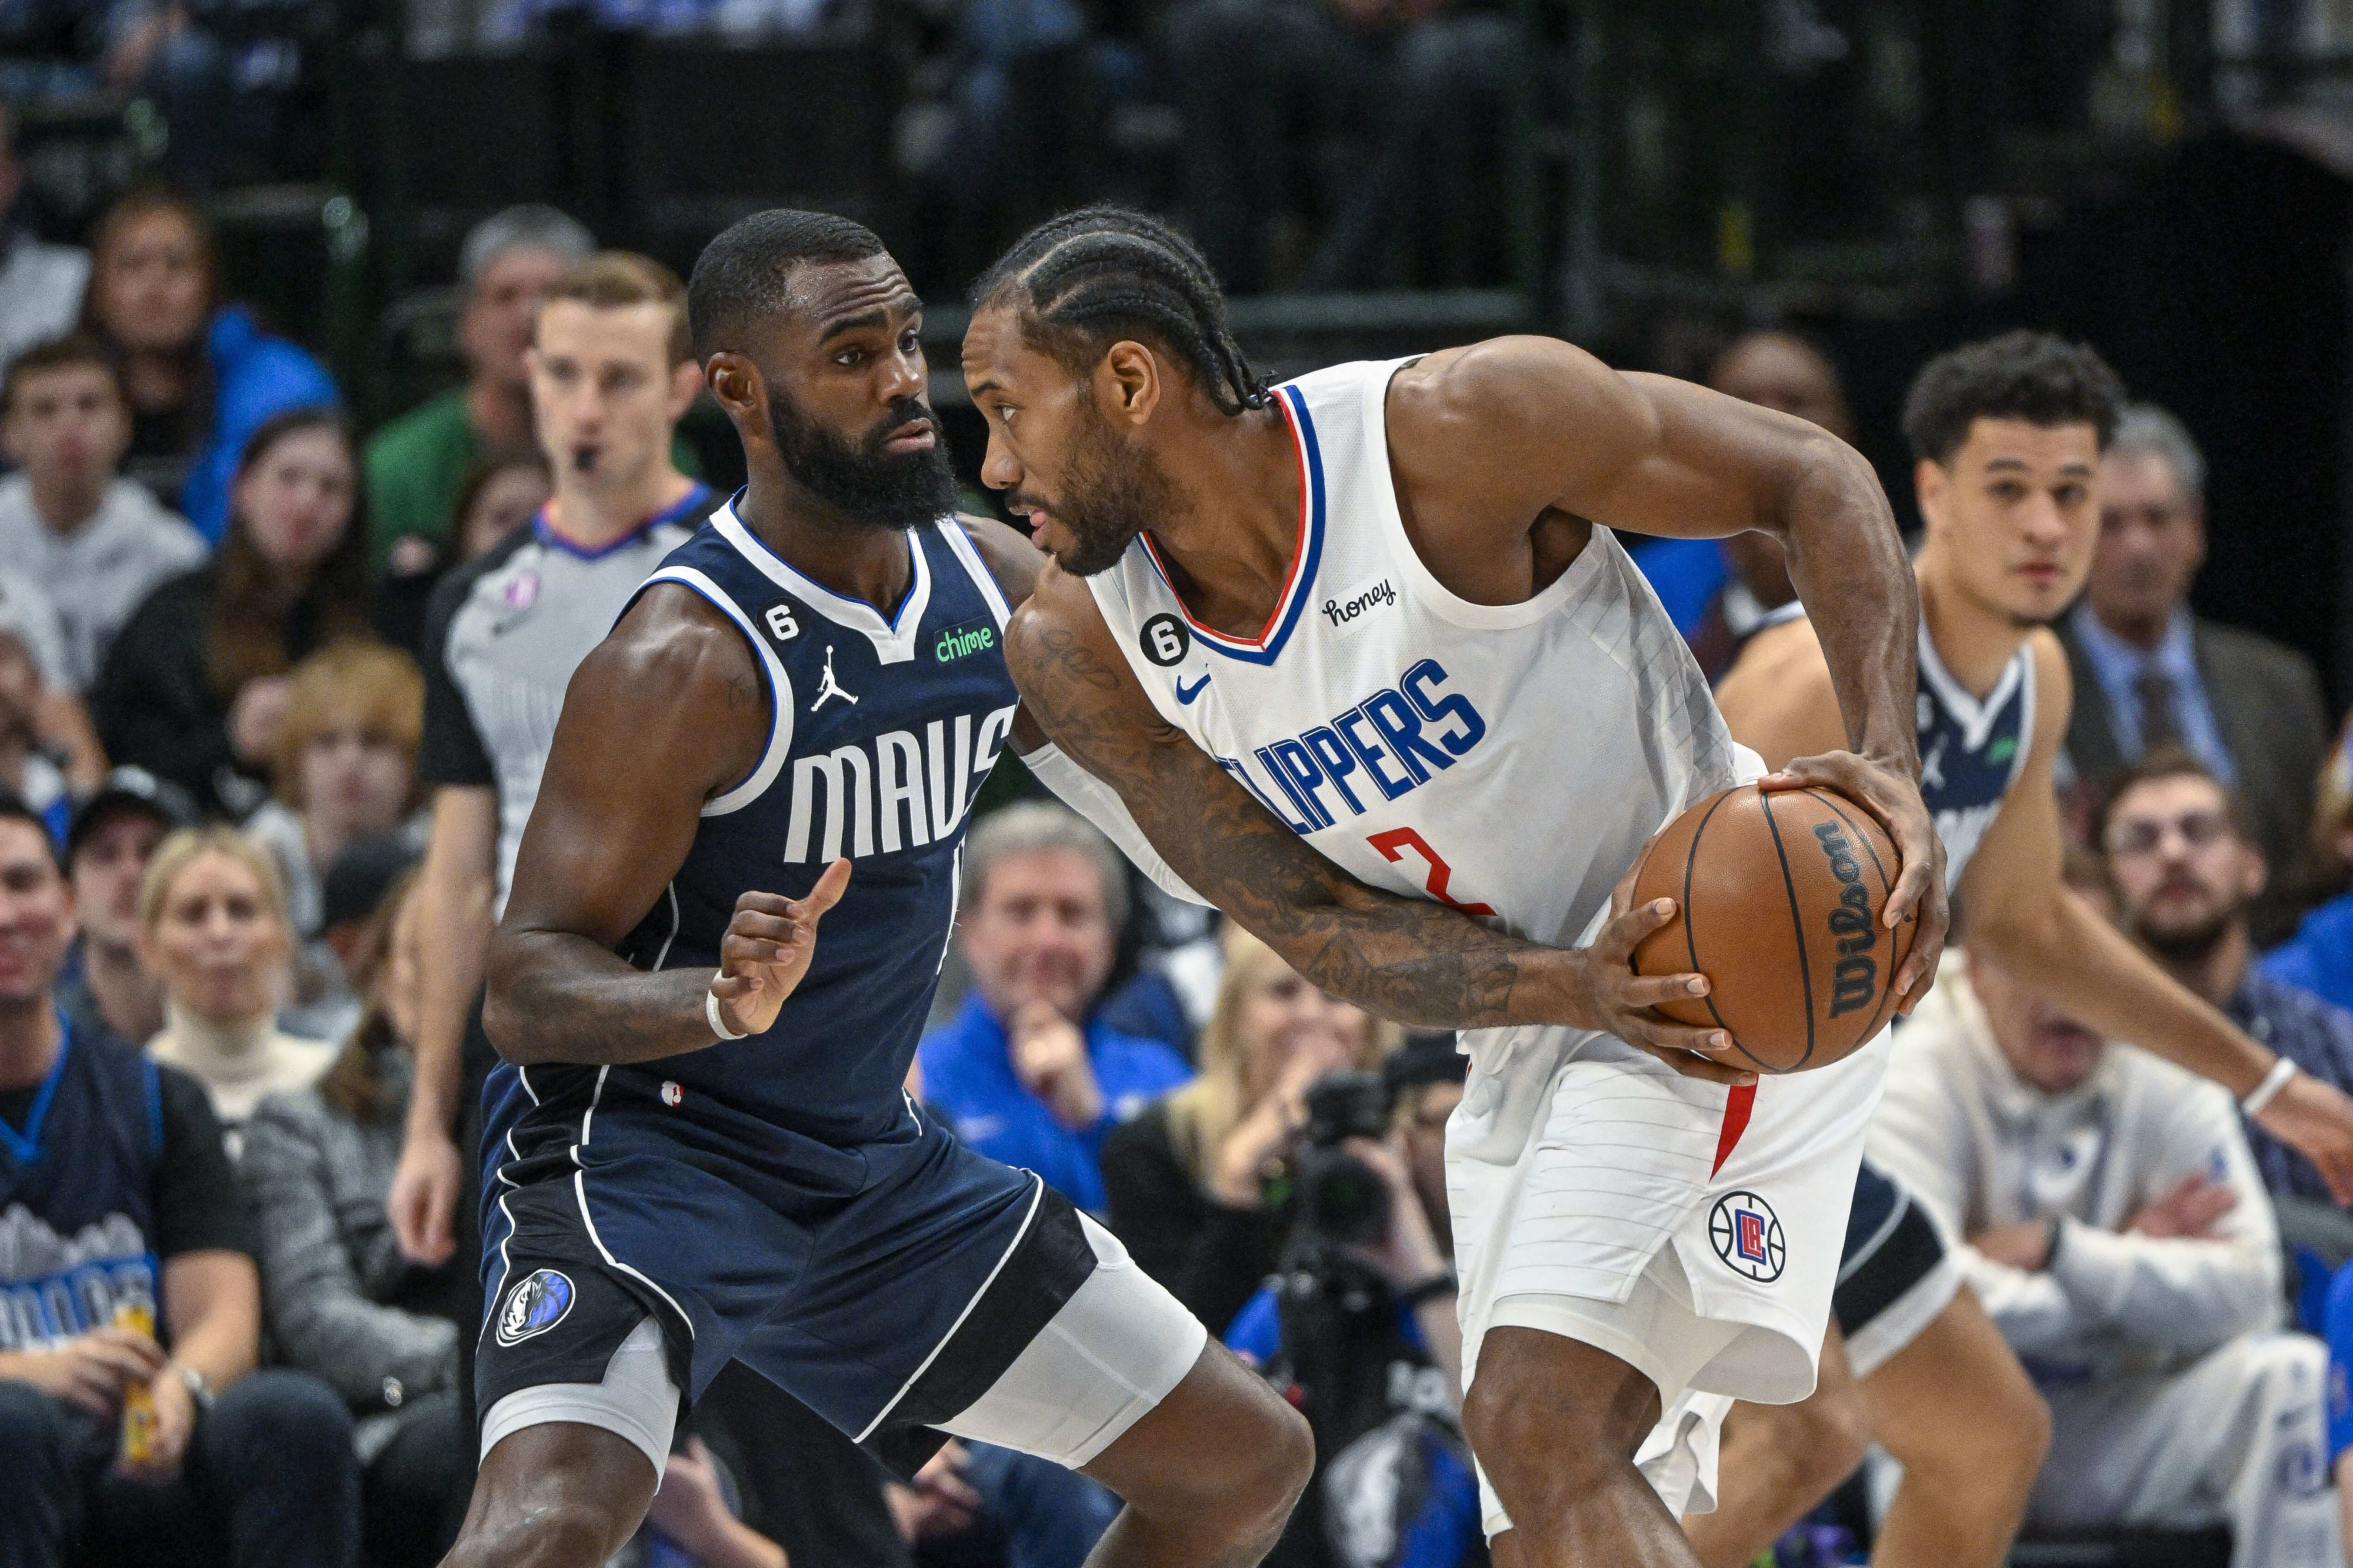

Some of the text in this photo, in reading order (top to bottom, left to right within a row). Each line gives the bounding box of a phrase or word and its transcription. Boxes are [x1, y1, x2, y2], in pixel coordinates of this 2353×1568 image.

[765, 604, 799, 640] 6
[1322, 578, 1396, 627] honey
[936, 627, 994, 662] chime
[1150, 620, 1182, 660] 6
[1365, 826, 1499, 917] 2
[1813, 820, 1877, 1019] Wilson
